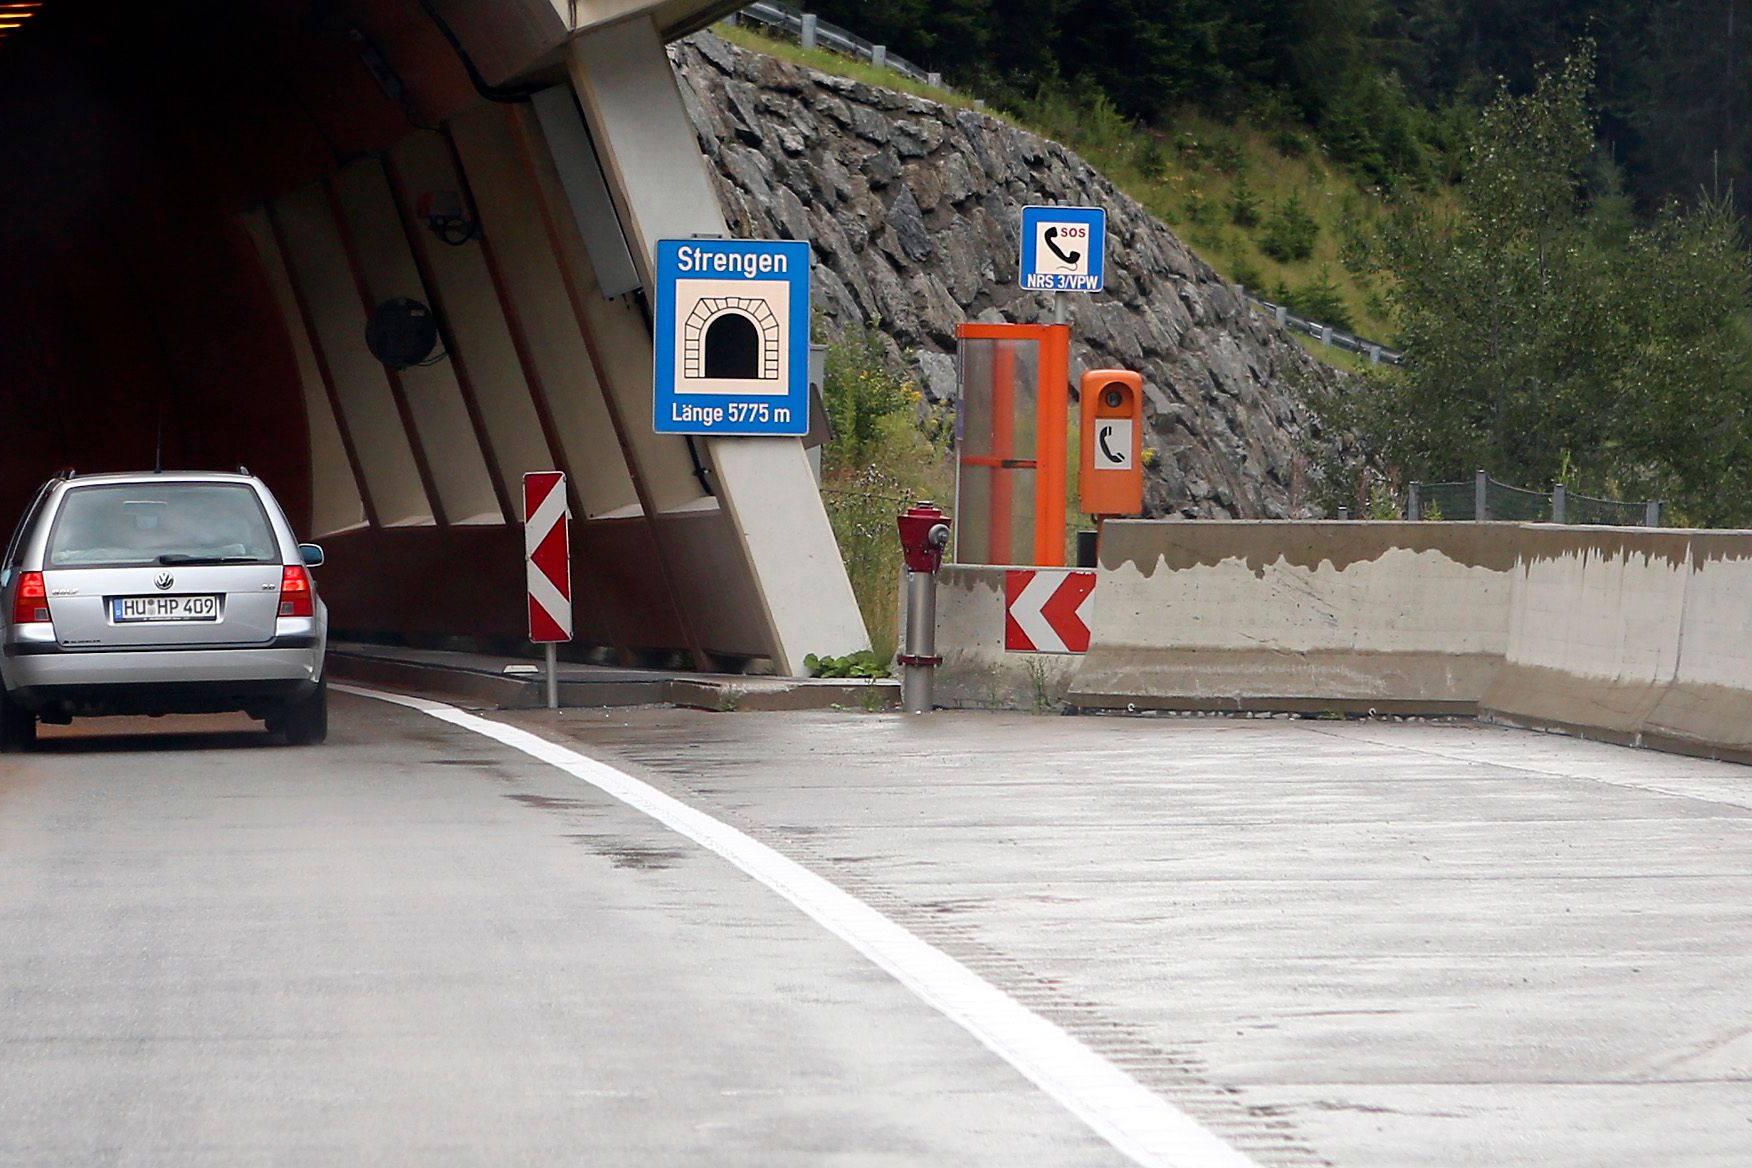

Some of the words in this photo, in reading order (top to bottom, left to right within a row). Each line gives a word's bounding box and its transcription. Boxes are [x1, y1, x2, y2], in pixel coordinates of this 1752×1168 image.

[1060, 227, 1086, 238] SOS
[677, 246, 788, 278] Strengen
[1027, 274, 1055, 289] NRS
[1057, 275, 1099, 290] 3/VPW
[672, 402, 723, 426] Länge
[728, 403, 769, 423] 5775
[774, 408, 791, 423] m
[124, 599, 146, 616] HU
[158, 599, 179, 614] HP
[183, 598, 214, 614] 409
